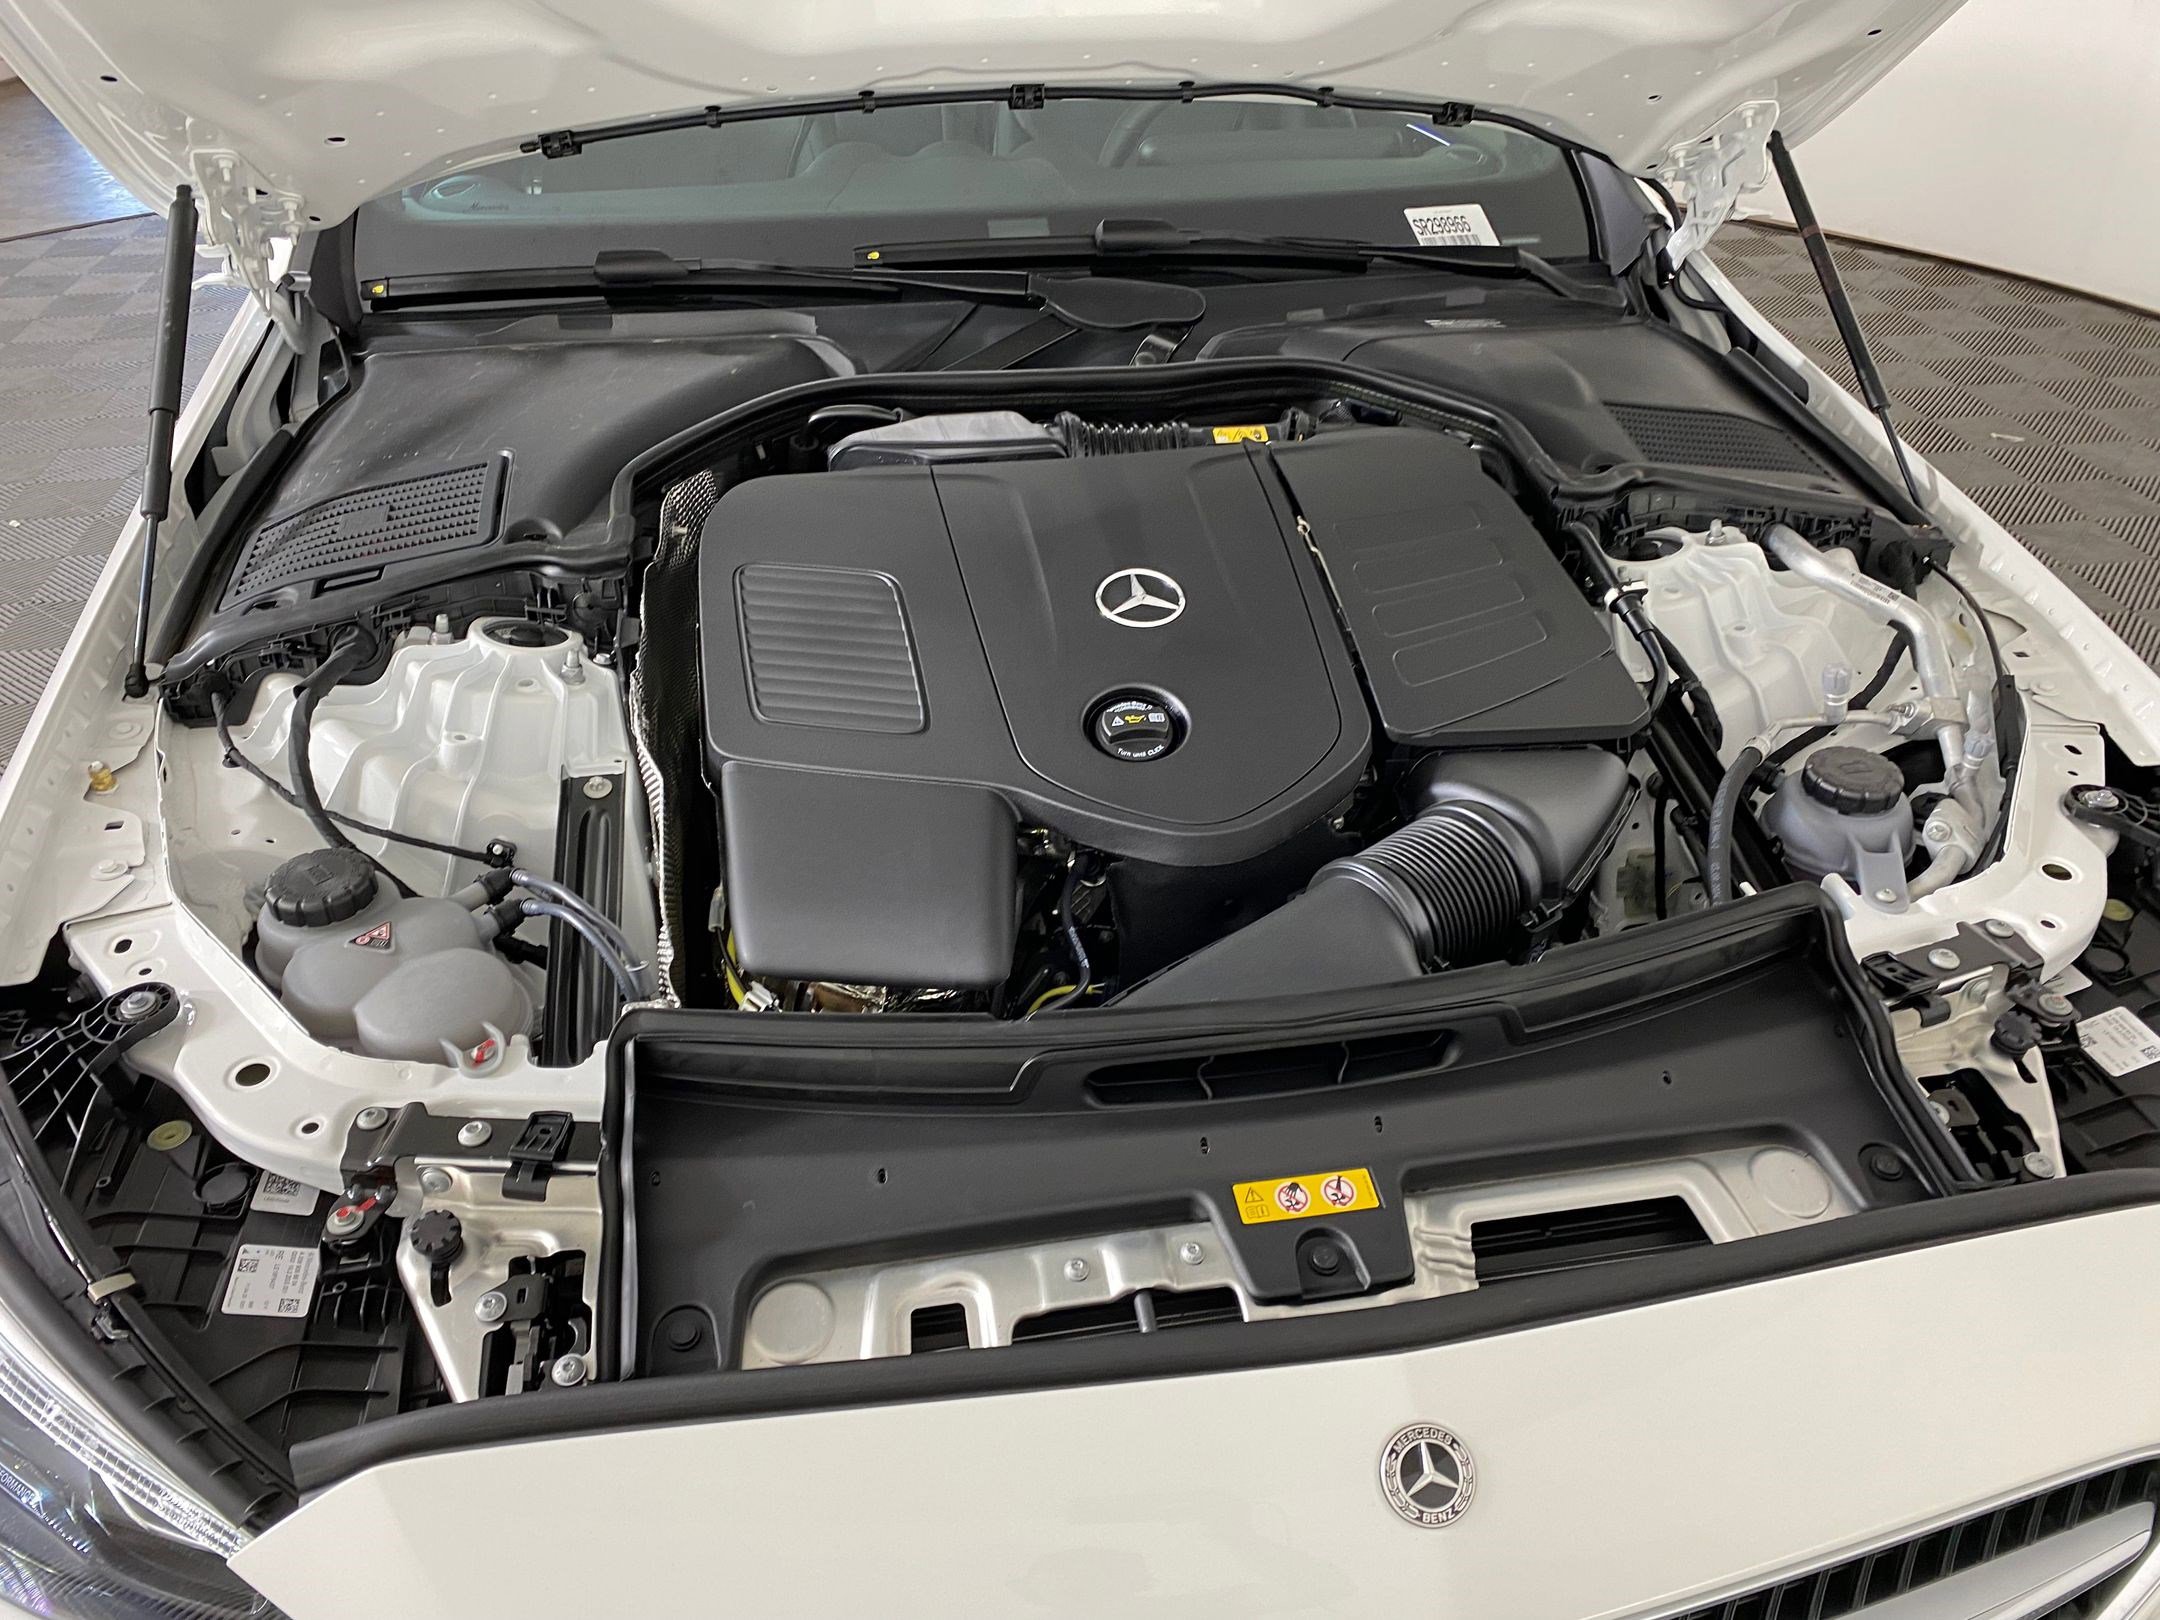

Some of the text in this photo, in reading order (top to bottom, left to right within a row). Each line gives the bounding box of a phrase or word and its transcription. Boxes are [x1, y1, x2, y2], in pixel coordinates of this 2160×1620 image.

[1412, 215, 1472, 237] SR298966
[1117, 747, 1131, 757] Turn
[1147, 744, 1164, 756] CLICK
[1393, 1428, 1453, 1453] MERCEDES
[1422, 1508, 1456, 1524] BENZ
